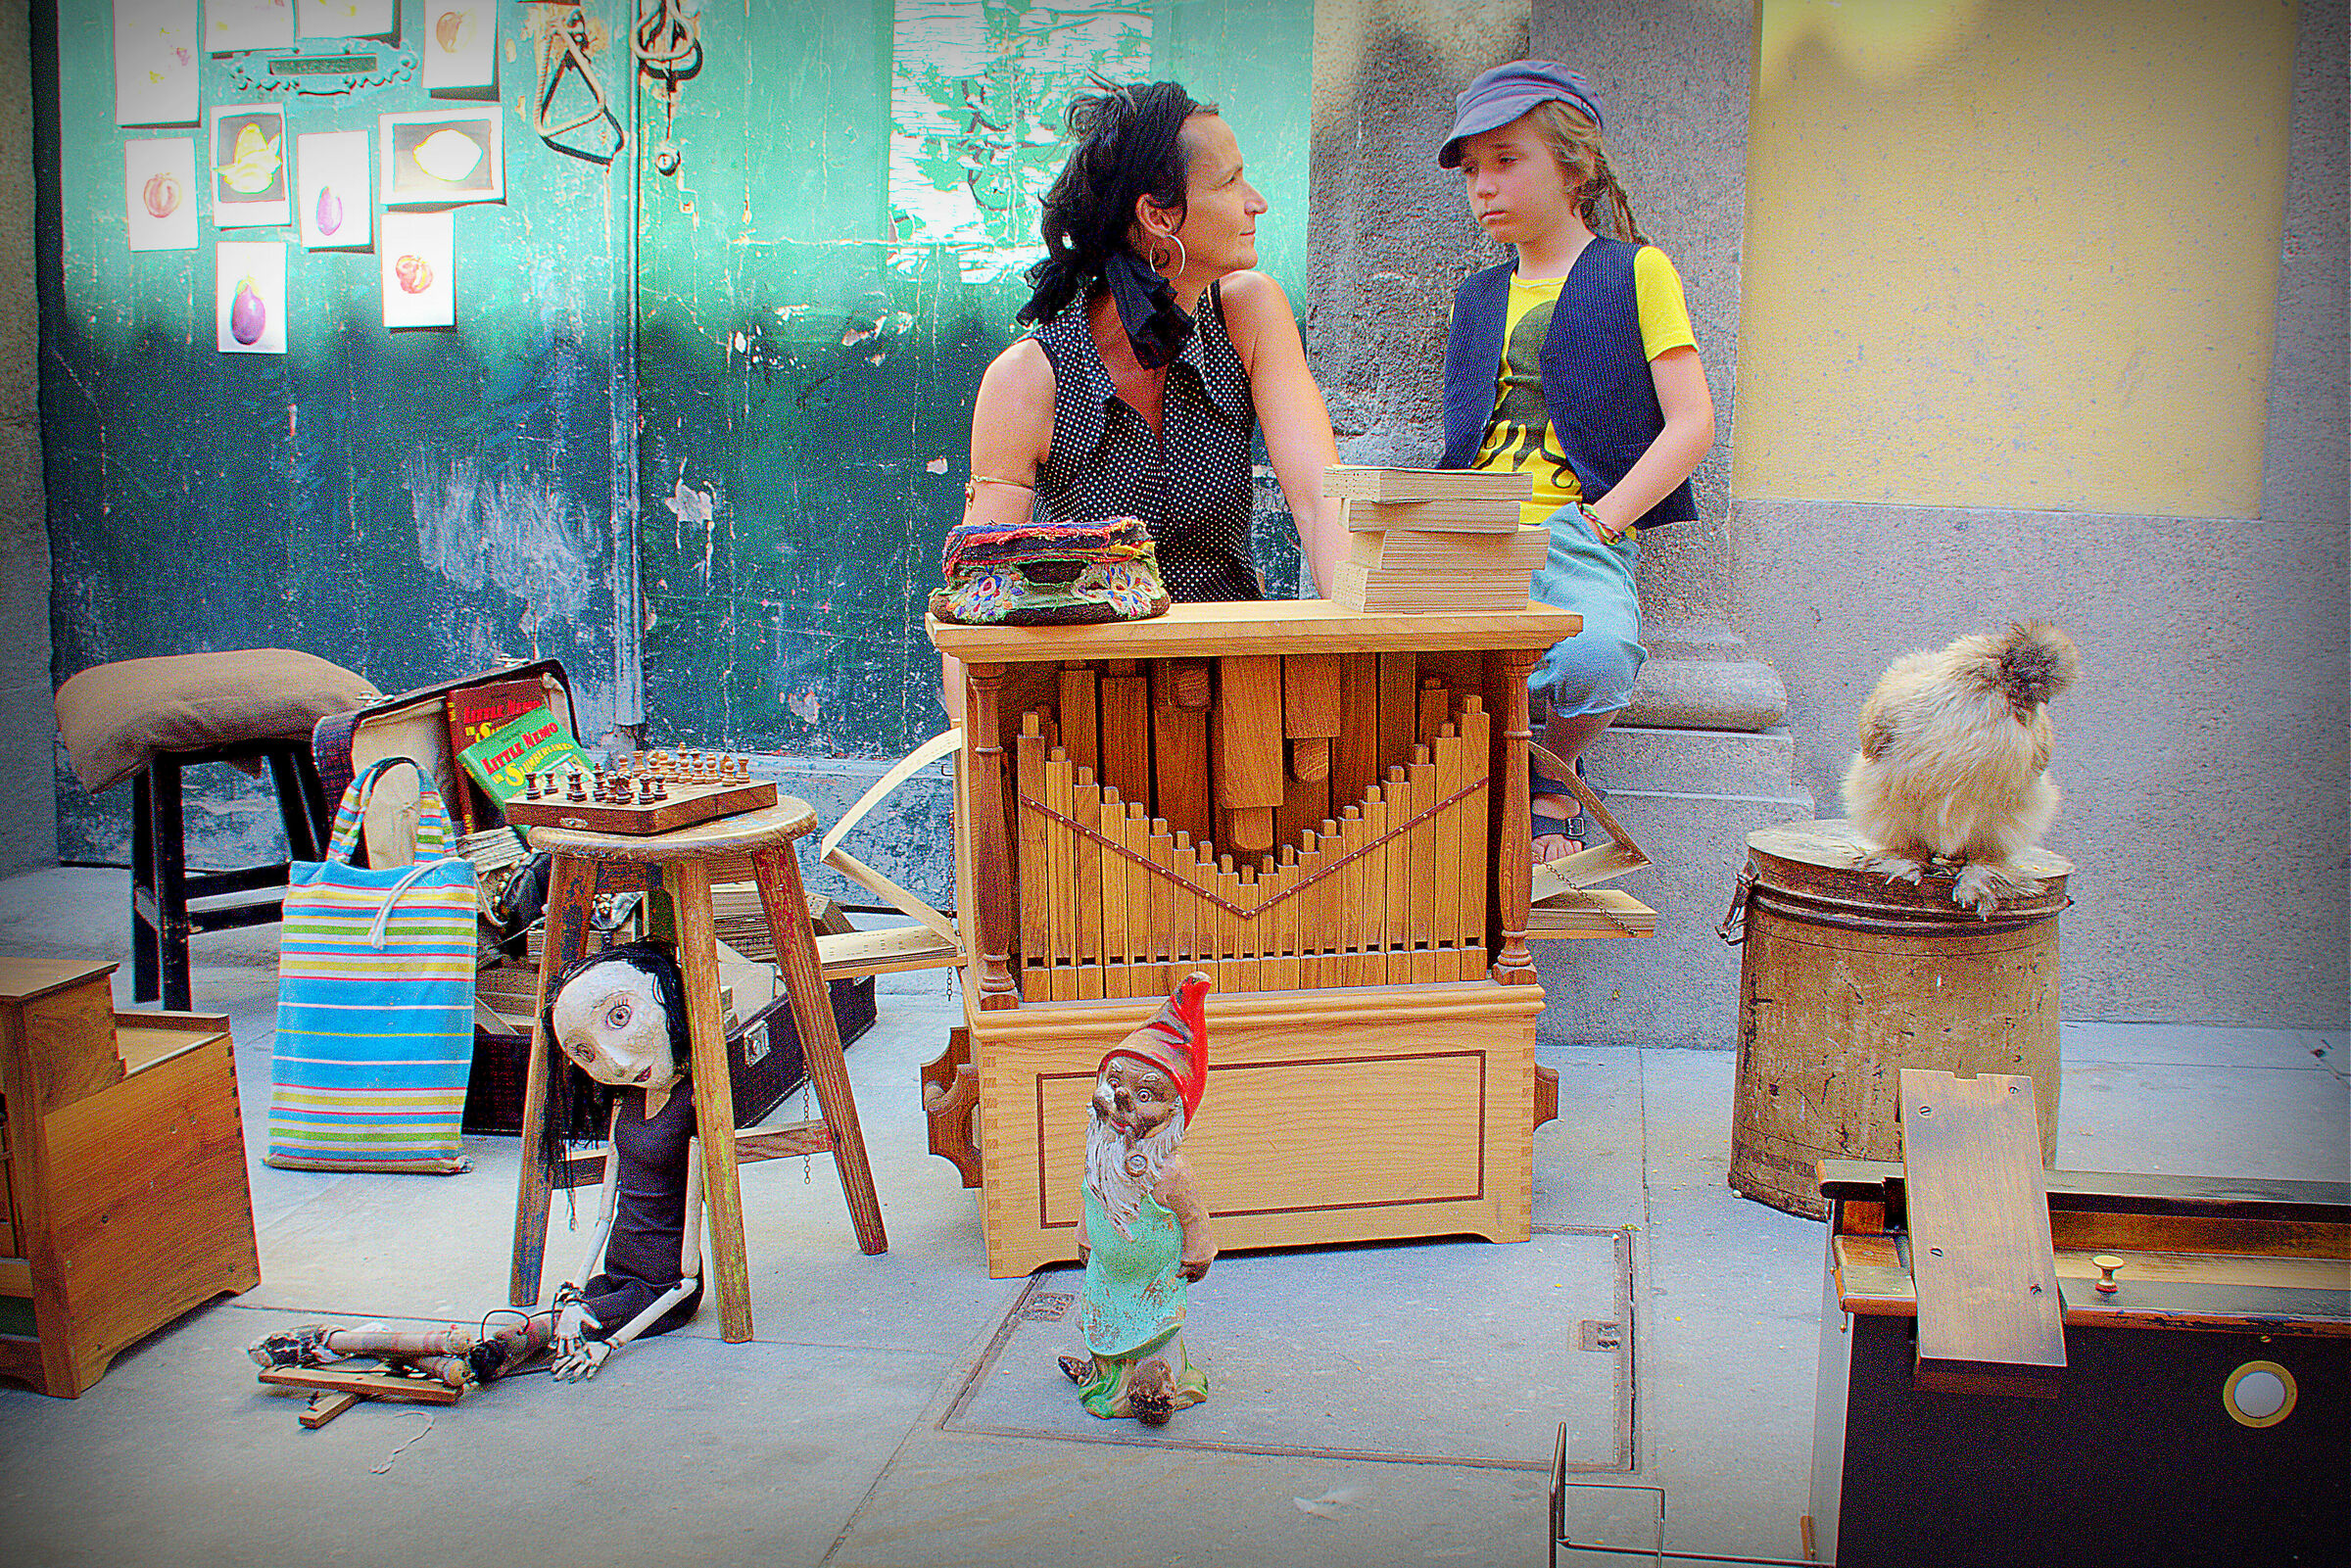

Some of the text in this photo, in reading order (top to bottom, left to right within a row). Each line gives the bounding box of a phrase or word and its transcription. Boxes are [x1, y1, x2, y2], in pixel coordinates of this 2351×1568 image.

[463, 705, 504, 724] LITTLE
[480, 741, 525, 776] LITTLE
[521, 722, 558, 749] NEMO
